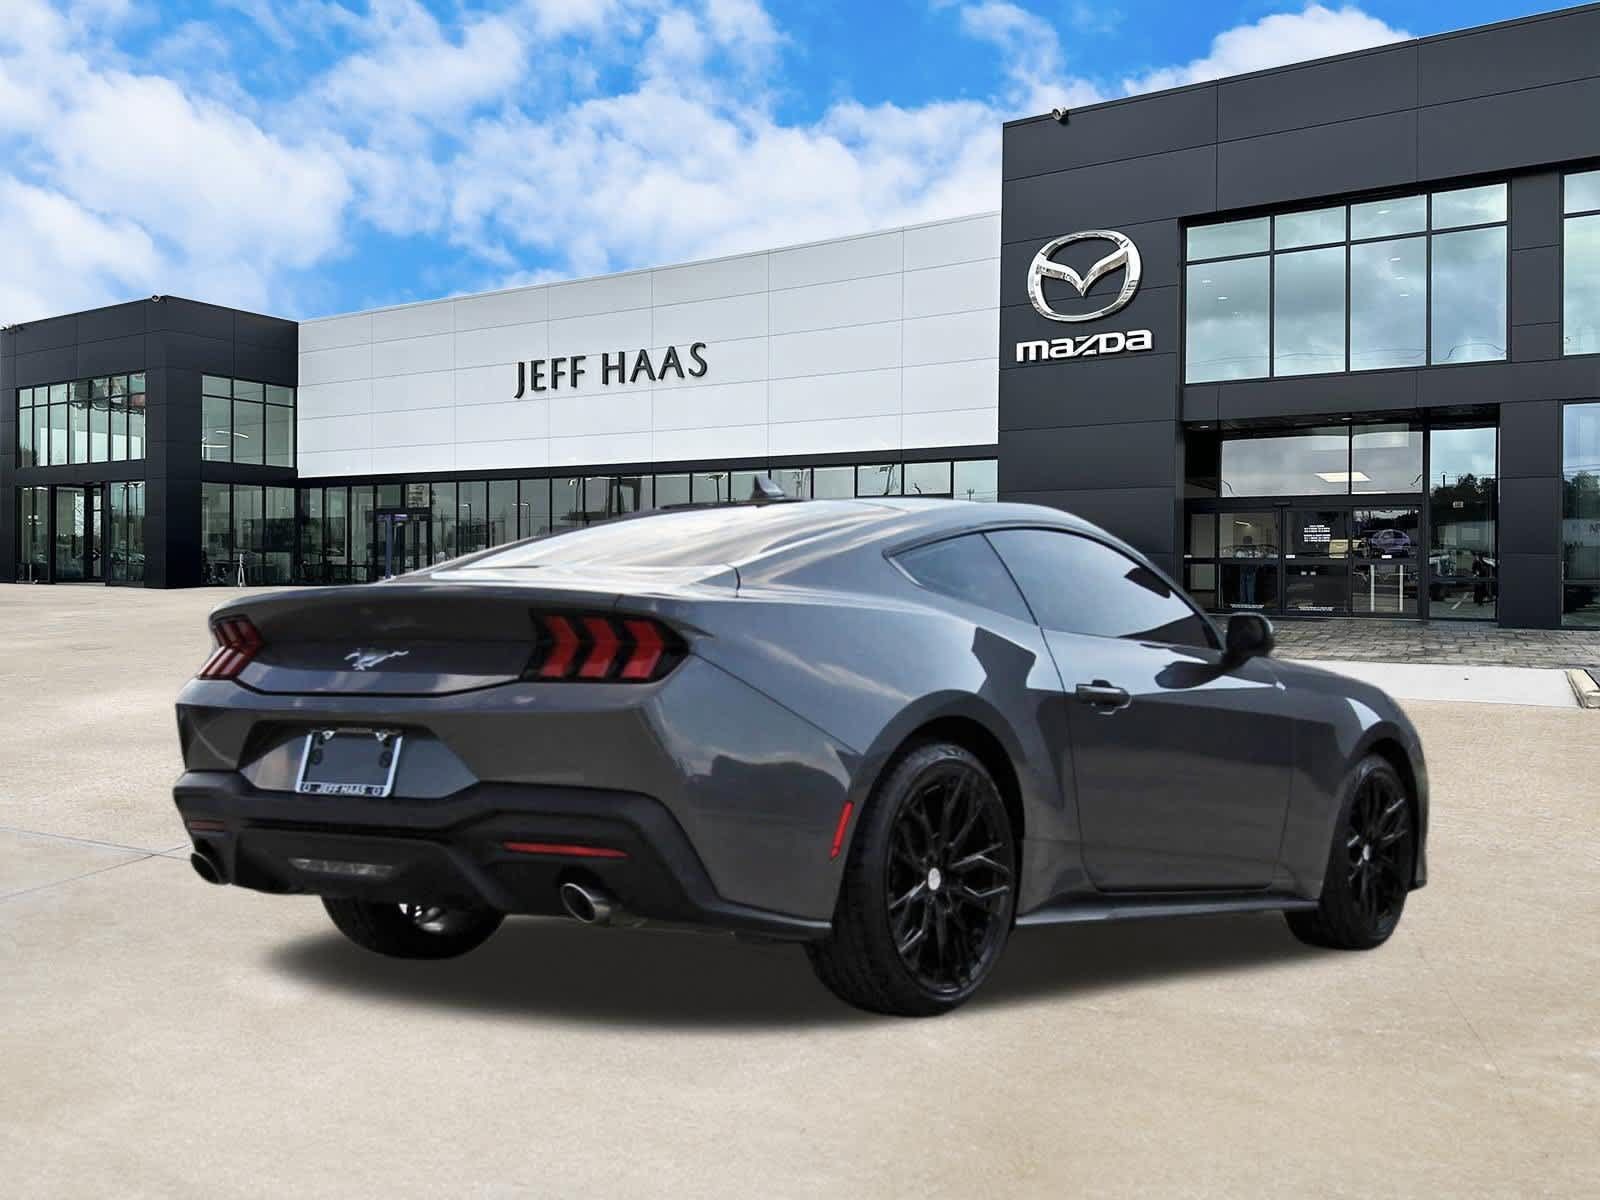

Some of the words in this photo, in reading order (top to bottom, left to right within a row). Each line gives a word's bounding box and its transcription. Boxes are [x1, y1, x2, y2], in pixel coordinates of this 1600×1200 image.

[514, 355, 586, 399] JEFF
[601, 342, 708, 385] HAAS
[317, 784, 339, 793] JEFF
[340, 784, 366, 794] HAAS
